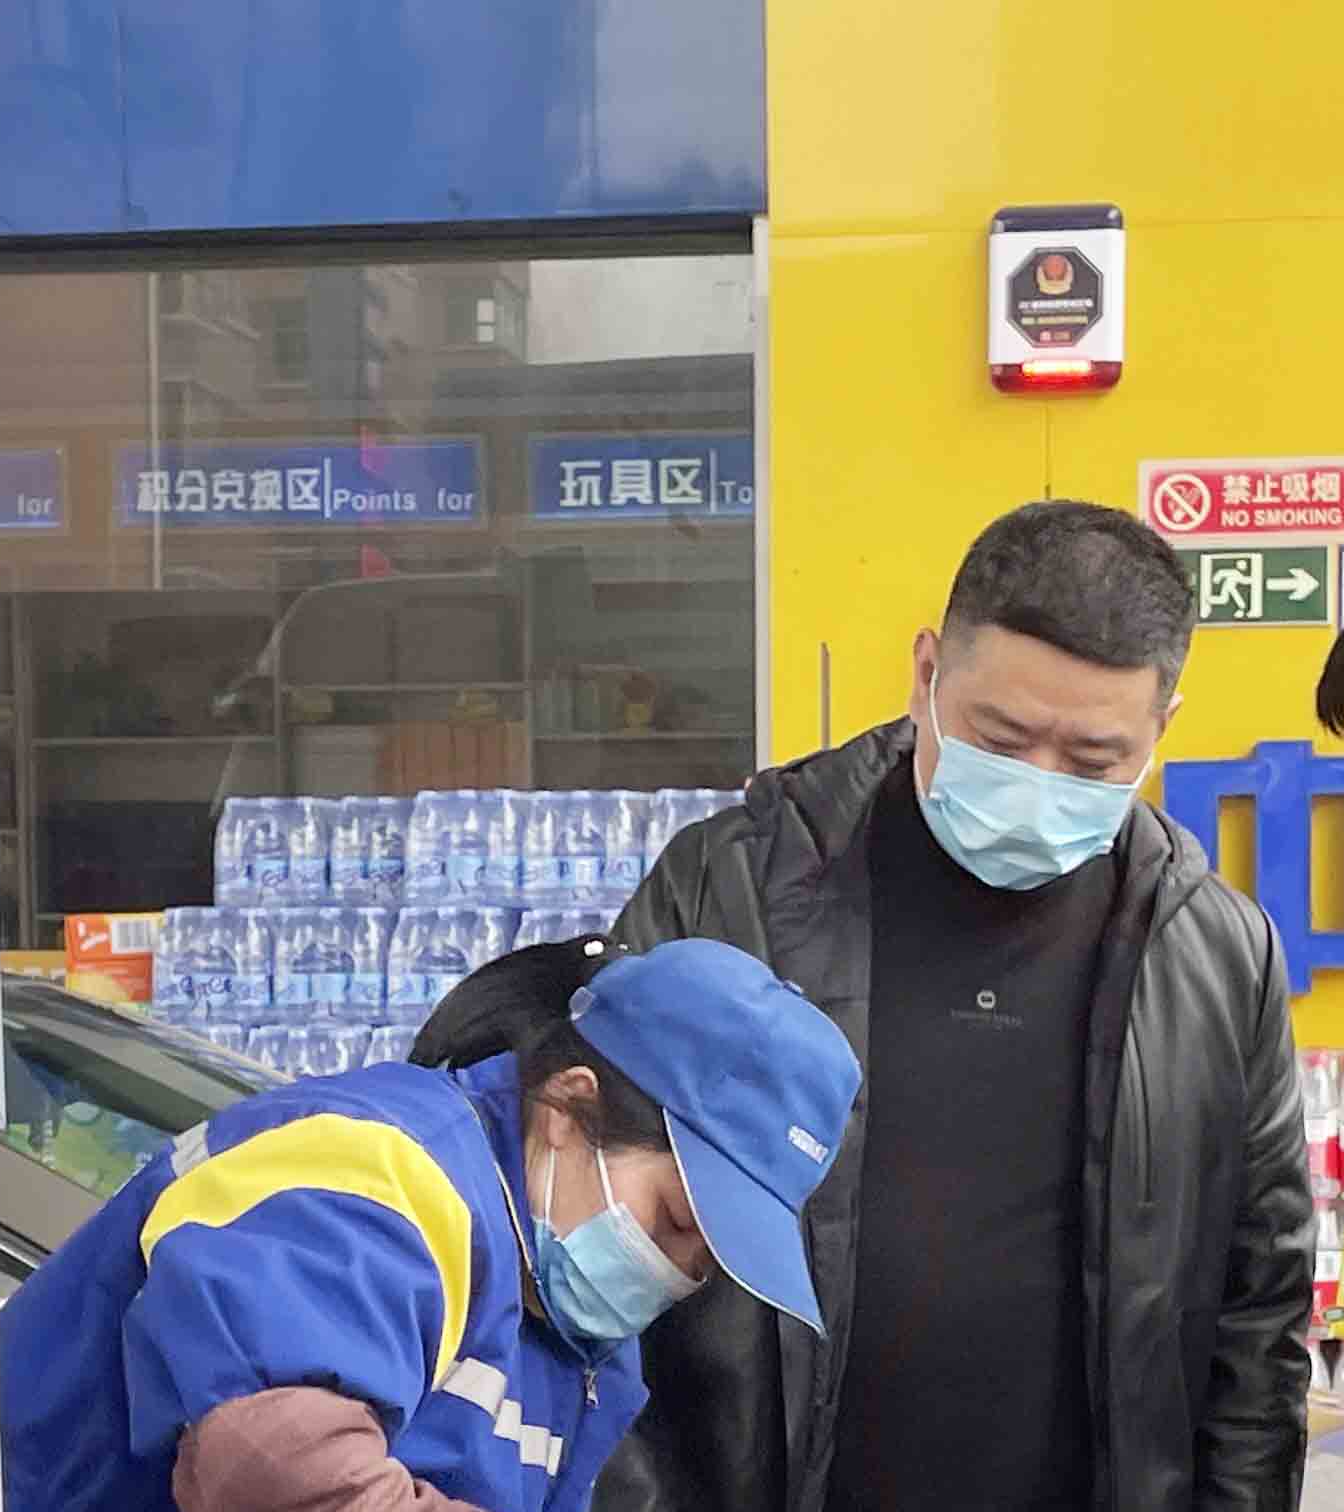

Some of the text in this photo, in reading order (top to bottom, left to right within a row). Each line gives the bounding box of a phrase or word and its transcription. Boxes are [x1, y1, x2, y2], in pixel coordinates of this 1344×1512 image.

[136, 468, 473, 513] 积分兑换区 Points for
[559, 458, 703, 507] 玩具区
[1221, 472, 1341, 505] 禁止吸烟
[1220, 506, 1343, 528] NO SMOKING
